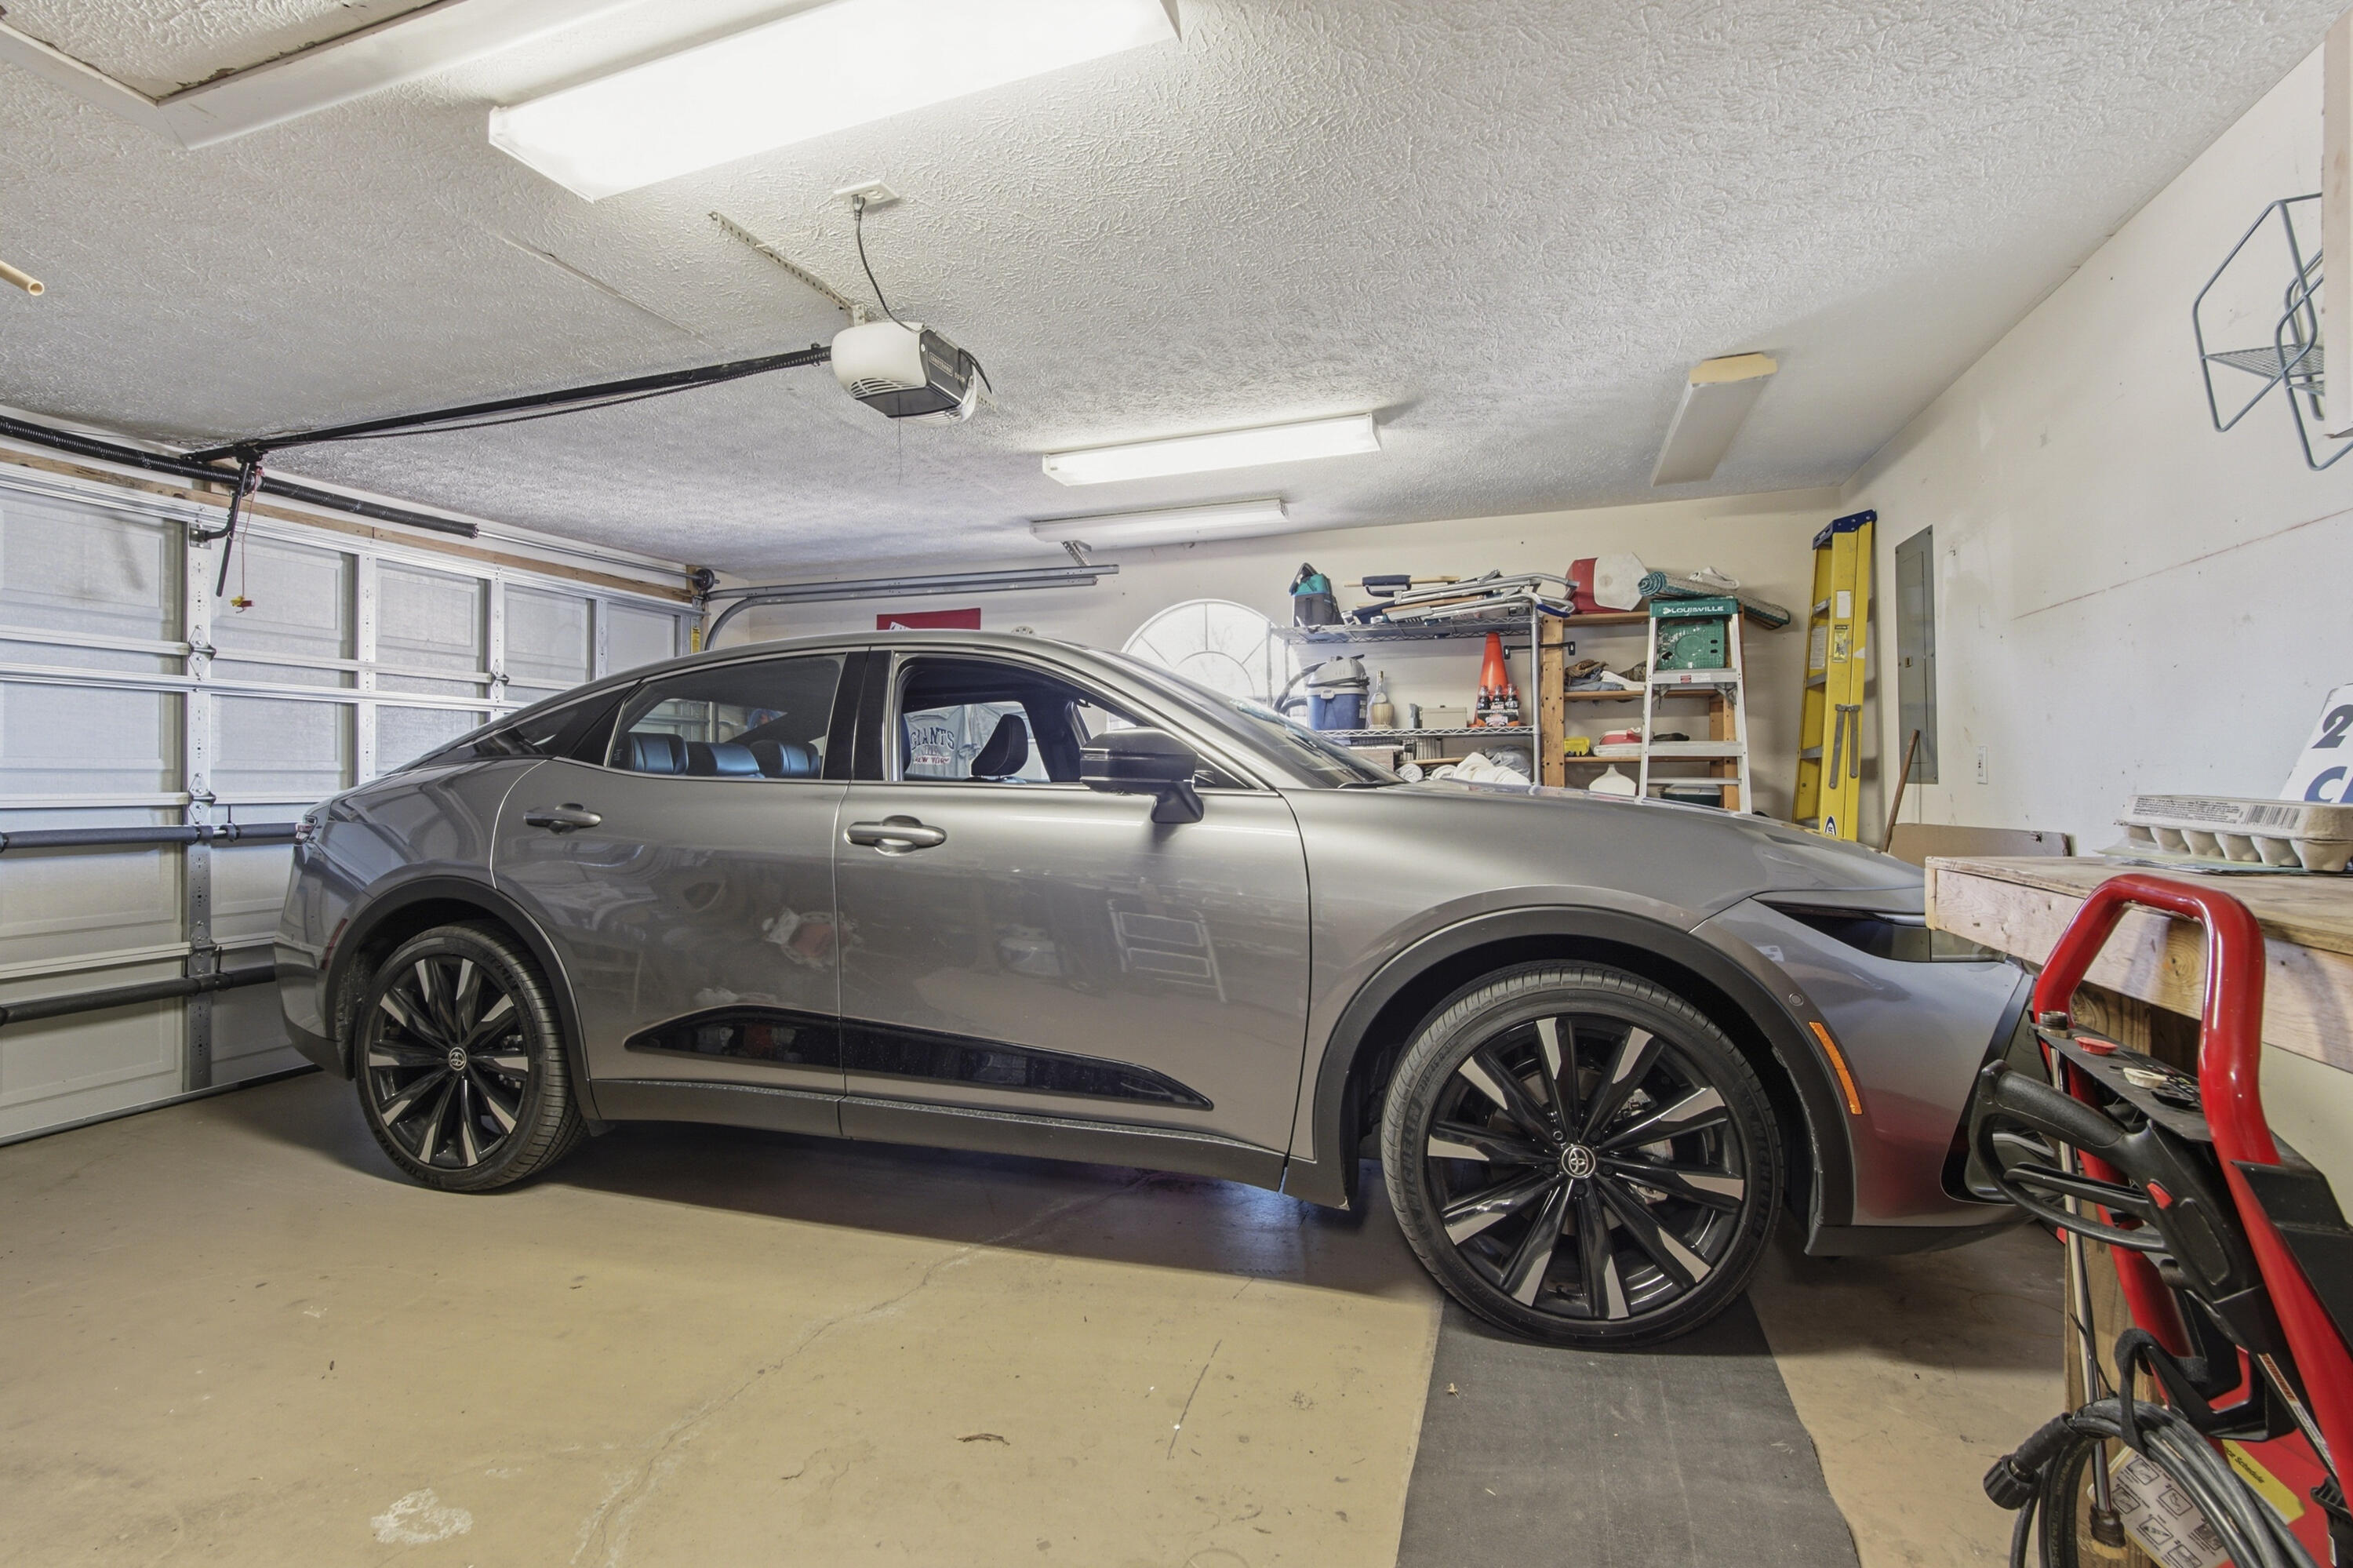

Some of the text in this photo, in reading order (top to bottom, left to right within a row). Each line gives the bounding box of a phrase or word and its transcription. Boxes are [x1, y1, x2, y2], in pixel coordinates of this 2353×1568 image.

[910, 726, 955, 751] GIANTS
[2310, 704, 2353, 749] 2
[1401, 1105, 1422, 1216] MICHELIN
[2235, 1456, 2266, 1484] Schedule
